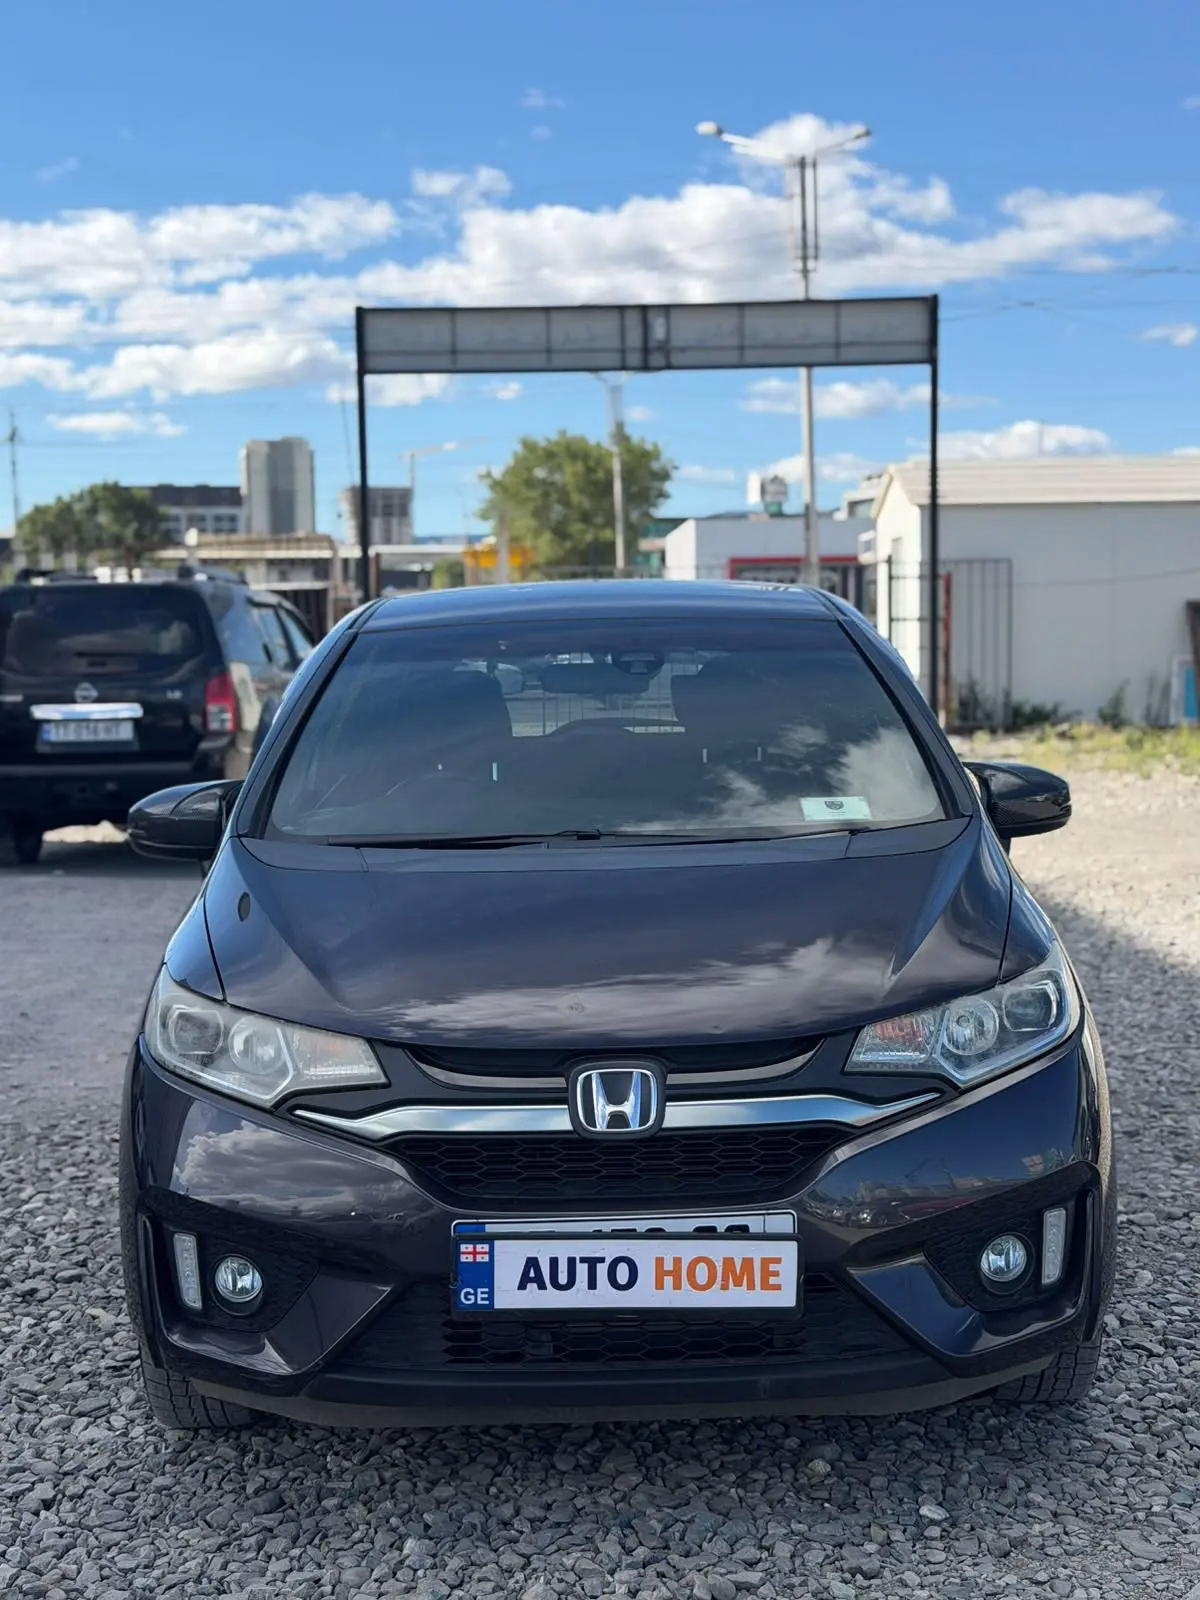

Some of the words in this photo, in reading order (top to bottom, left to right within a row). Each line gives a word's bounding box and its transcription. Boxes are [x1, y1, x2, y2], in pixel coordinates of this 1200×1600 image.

[517, 1256, 639, 1292] AUTO
[654, 1256, 783, 1292] HOME
[460, 1287, 489, 1305] GE
